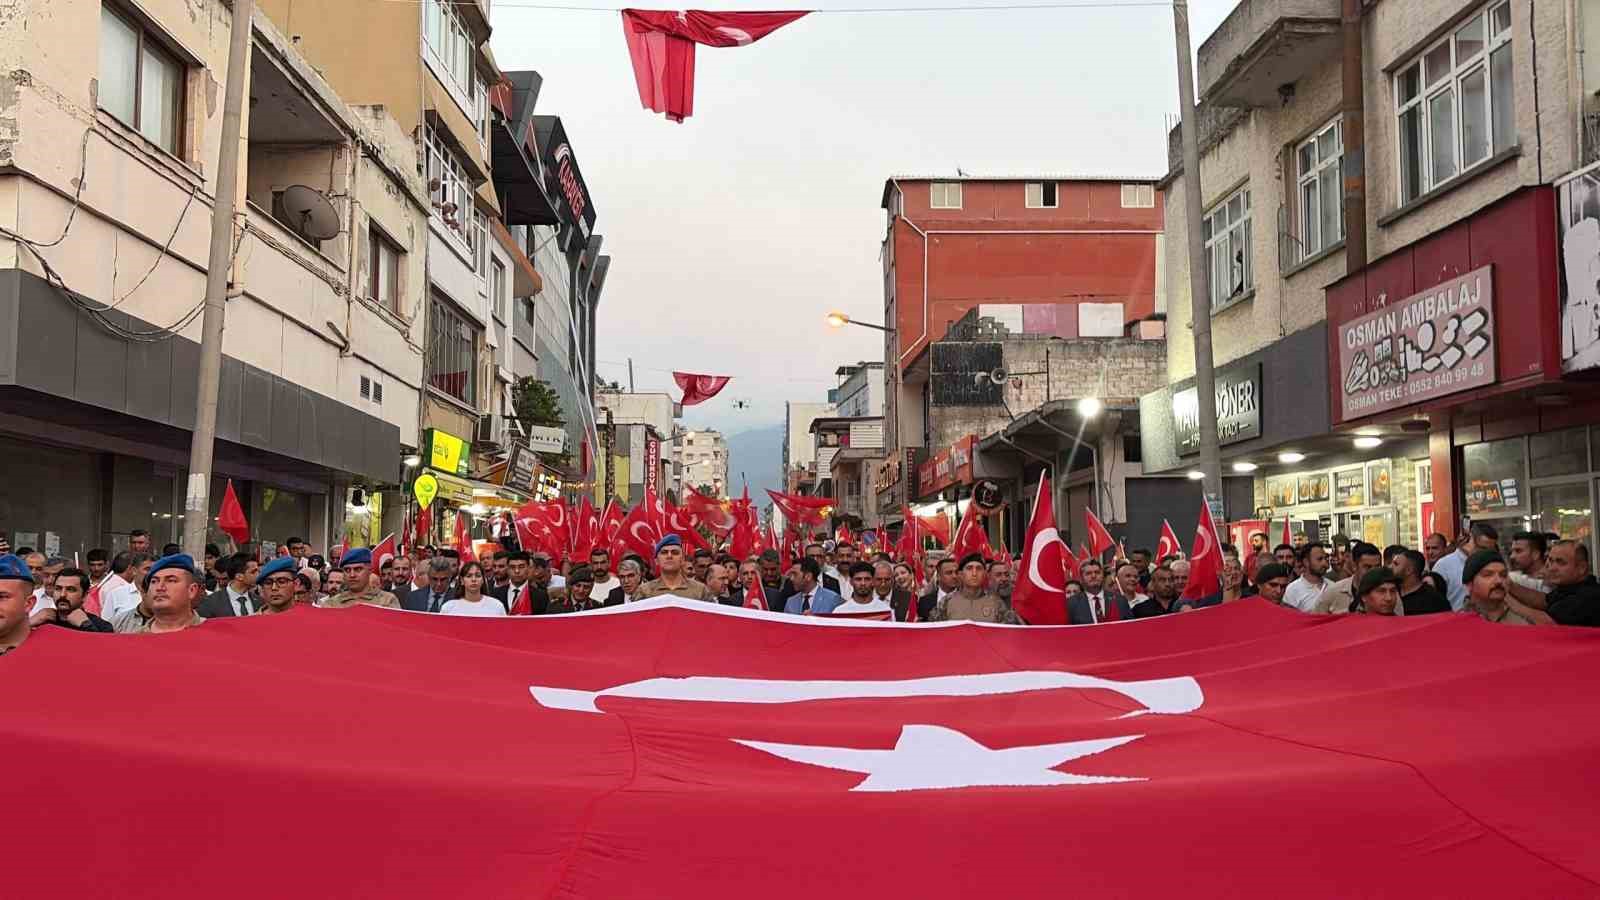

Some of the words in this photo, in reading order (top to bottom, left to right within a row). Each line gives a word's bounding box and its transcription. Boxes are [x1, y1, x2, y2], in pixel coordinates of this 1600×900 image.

[1347, 311, 1397, 348] OSMAN
[1401, 276, 1481, 330] AMBALAJ
[1349, 394, 1377, 411] OSMAN
[1379, 386, 1403, 401] TEKE
[1470, 362, 1484, 377] 48
